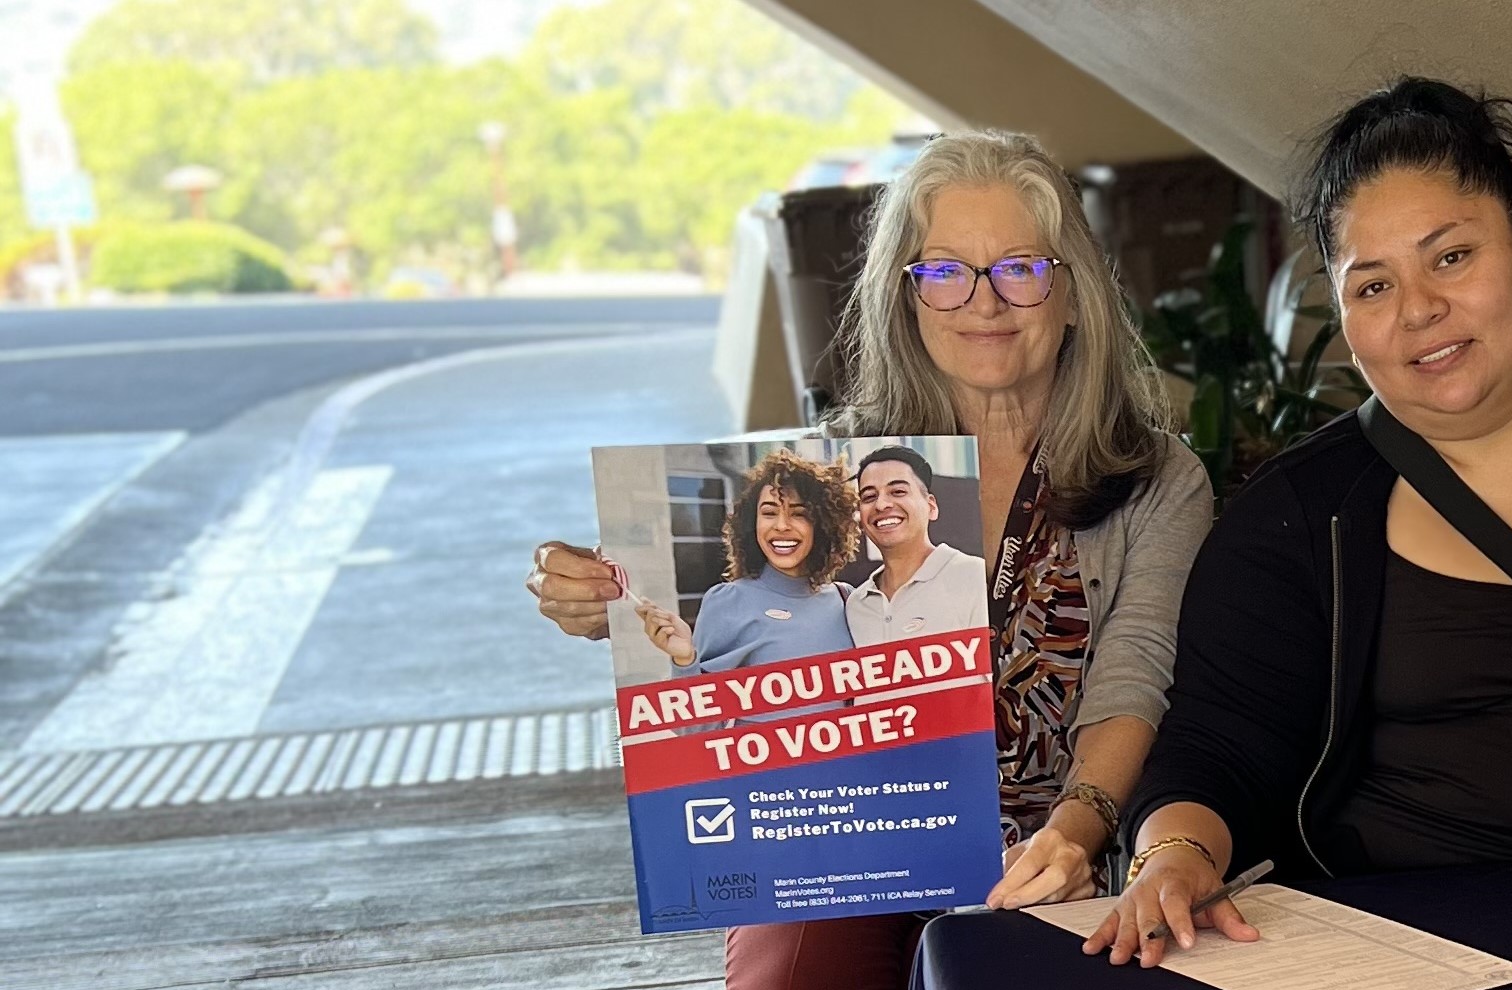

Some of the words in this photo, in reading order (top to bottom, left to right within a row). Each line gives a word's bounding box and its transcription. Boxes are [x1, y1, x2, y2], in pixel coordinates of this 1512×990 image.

[628, 683, 721, 730] ARE
[724, 666, 825, 711] YOU
[829, 637, 983, 695] READY
[704, 732, 770, 771] TO
[774, 704, 918, 759] VOTE?
[749, 789, 795, 803] Check
[798, 788, 834, 799] Your
[837, 785, 879, 797] Voter
[882, 782, 931, 795] Status
[933, 780, 949, 791] or
[750, 806, 815, 821] Register
[818, 802, 855, 815] Now!
[752, 814, 958, 841] RegisterToVote.ca.gov
[707, 872, 757, 888] MARIN
[774, 877, 797, 887] Marin
[798, 876, 827, 887] County
[828, 873, 864, 883] Elections
[864, 869, 910, 881] Department
[775, 886, 835, 898] MarinVotes.org
[776, 900, 791, 909] Toll
[871, 892, 885, 901] 711
